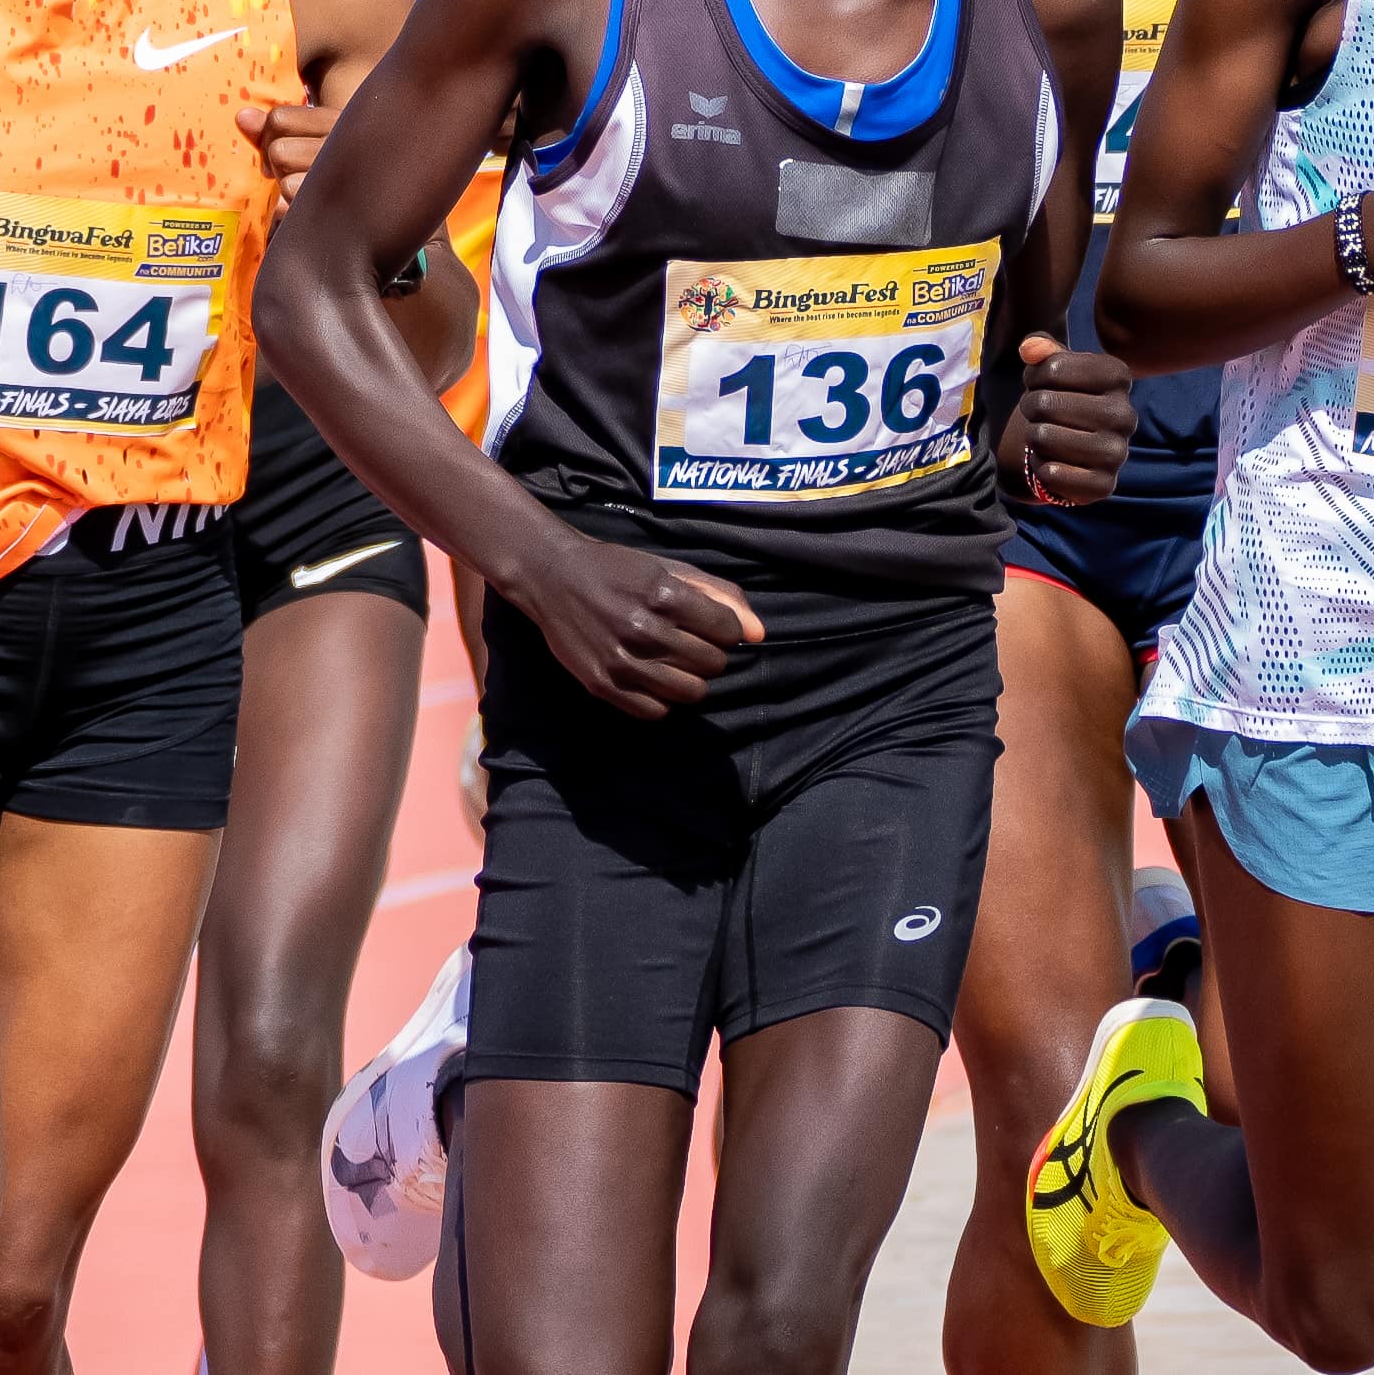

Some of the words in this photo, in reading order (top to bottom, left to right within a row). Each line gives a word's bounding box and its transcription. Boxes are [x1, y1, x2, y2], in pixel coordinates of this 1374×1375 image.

[670, 120, 742, 146] erima
[151, 266, 219, 277] COMMUNITY
[930, 262, 964, 273] POWERED
[752, 280, 899, 313] BingwaFest
[914, 269, 984, 304] Betika!
[769, 315, 792, 324] Where
[794, 313, 804, 323] the
[806, 313, 821, 322] best
[822, 312, 836, 321] rise
[837, 312, 845, 320] to
[846, 310, 872, 319] become
[874, 308, 900, 319] legends
[917, 300, 982, 323] COMMUNITY
[0, 388, 71, 418] FINALS
[87, 396, 151, 425] SIAYA
[152, 394, 192, 423] 2025
[719, 343, 946, 446] 136
[666, 456, 773, 490] NATIONAL
[776, 458, 849, 489] FINALS
[866, 444, 923, 479] SIAYA
[922, 432, 960, 464] 2025
